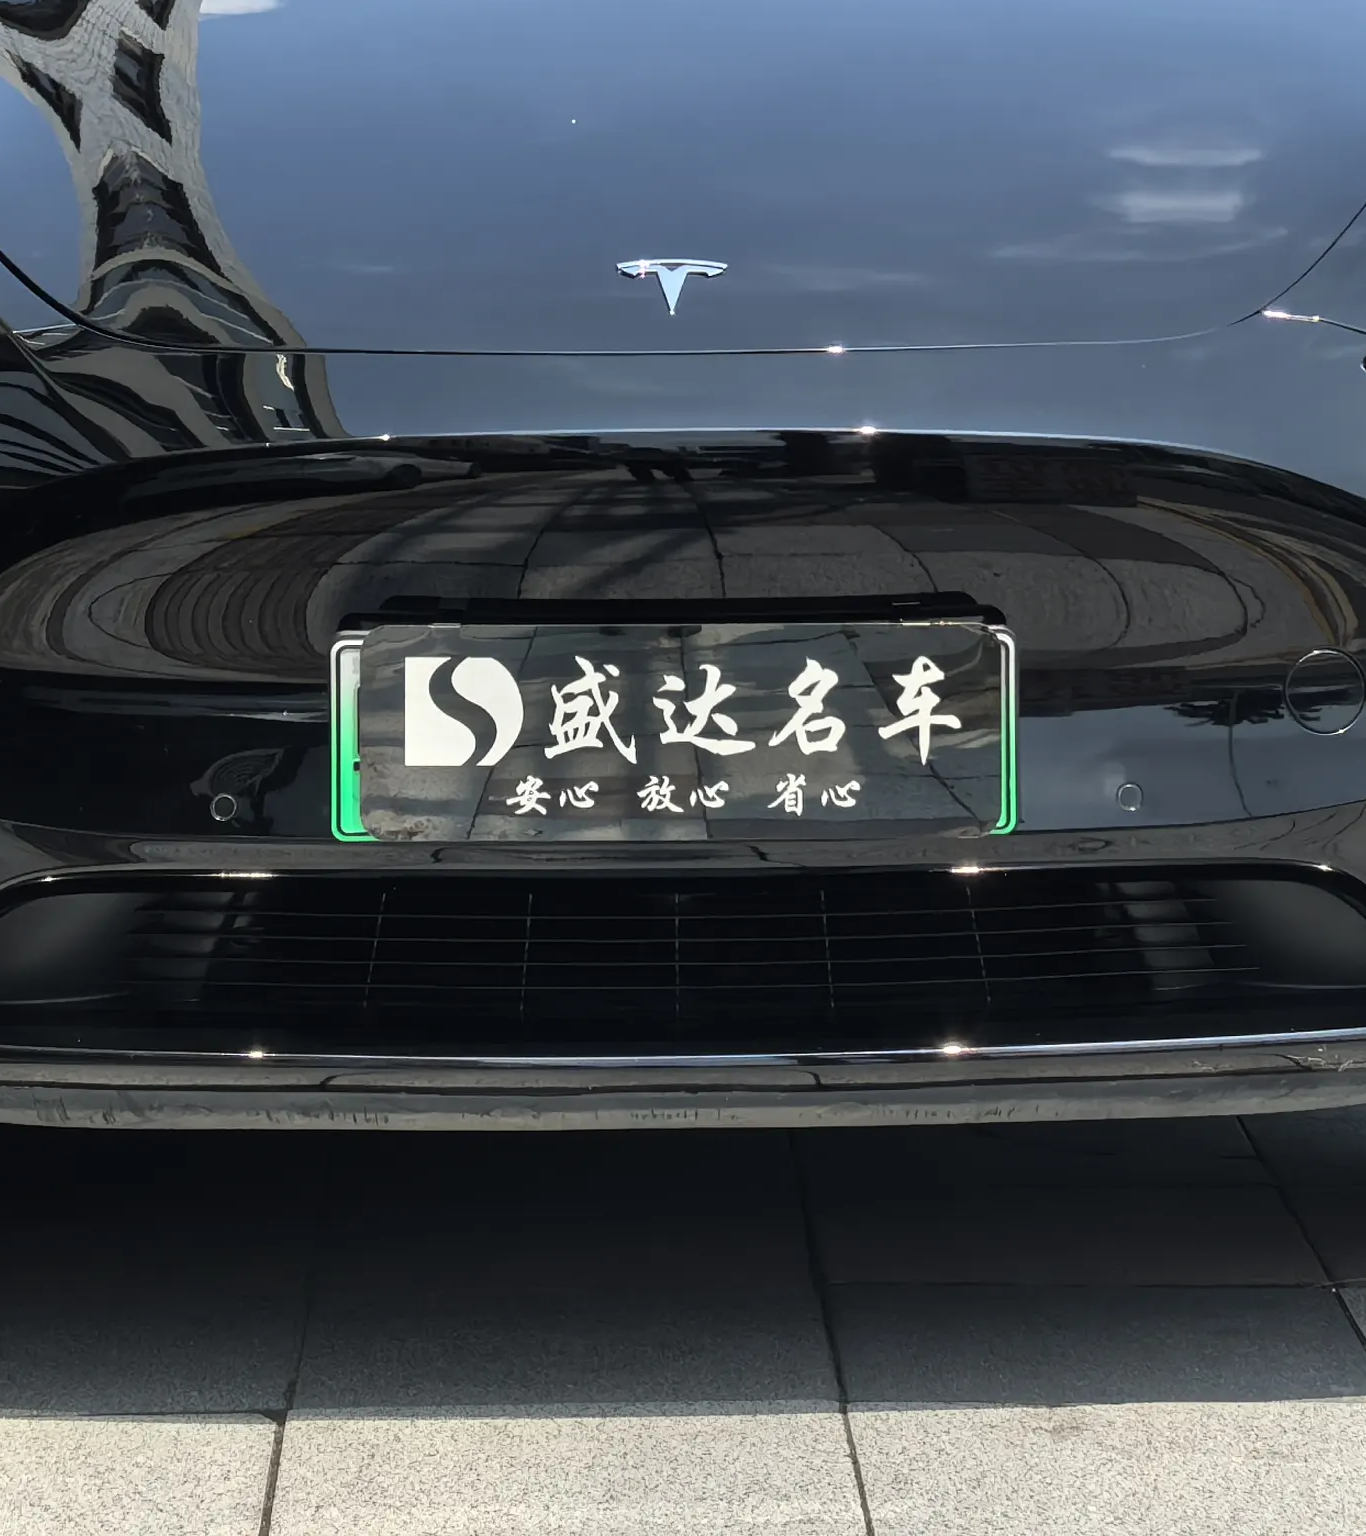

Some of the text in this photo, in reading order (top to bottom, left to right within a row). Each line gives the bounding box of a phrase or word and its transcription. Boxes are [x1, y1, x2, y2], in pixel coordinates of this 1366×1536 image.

[544, 655, 962, 765] 盛达名车
[506, 773, 861, 816] 安心 放心 省心
